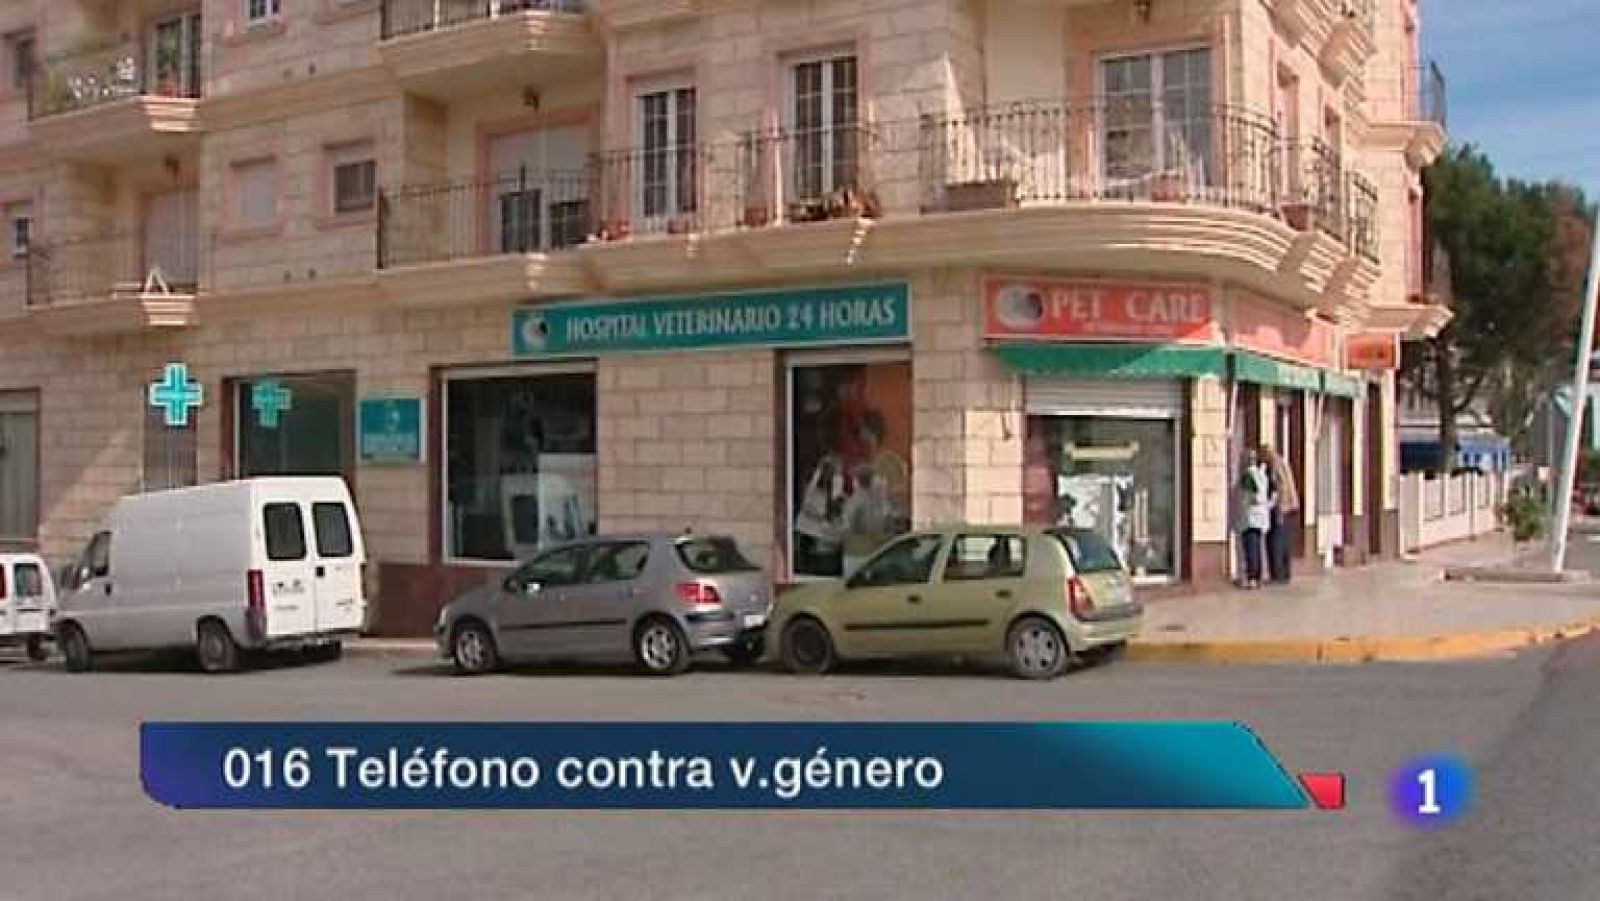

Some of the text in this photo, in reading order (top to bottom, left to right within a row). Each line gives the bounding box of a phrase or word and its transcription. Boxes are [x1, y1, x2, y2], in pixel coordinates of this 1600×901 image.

[565, 296, 897, 345] HOSPITAL VETERINARIO 24 HORAS
[1051, 287, 1209, 323] PET CARE
